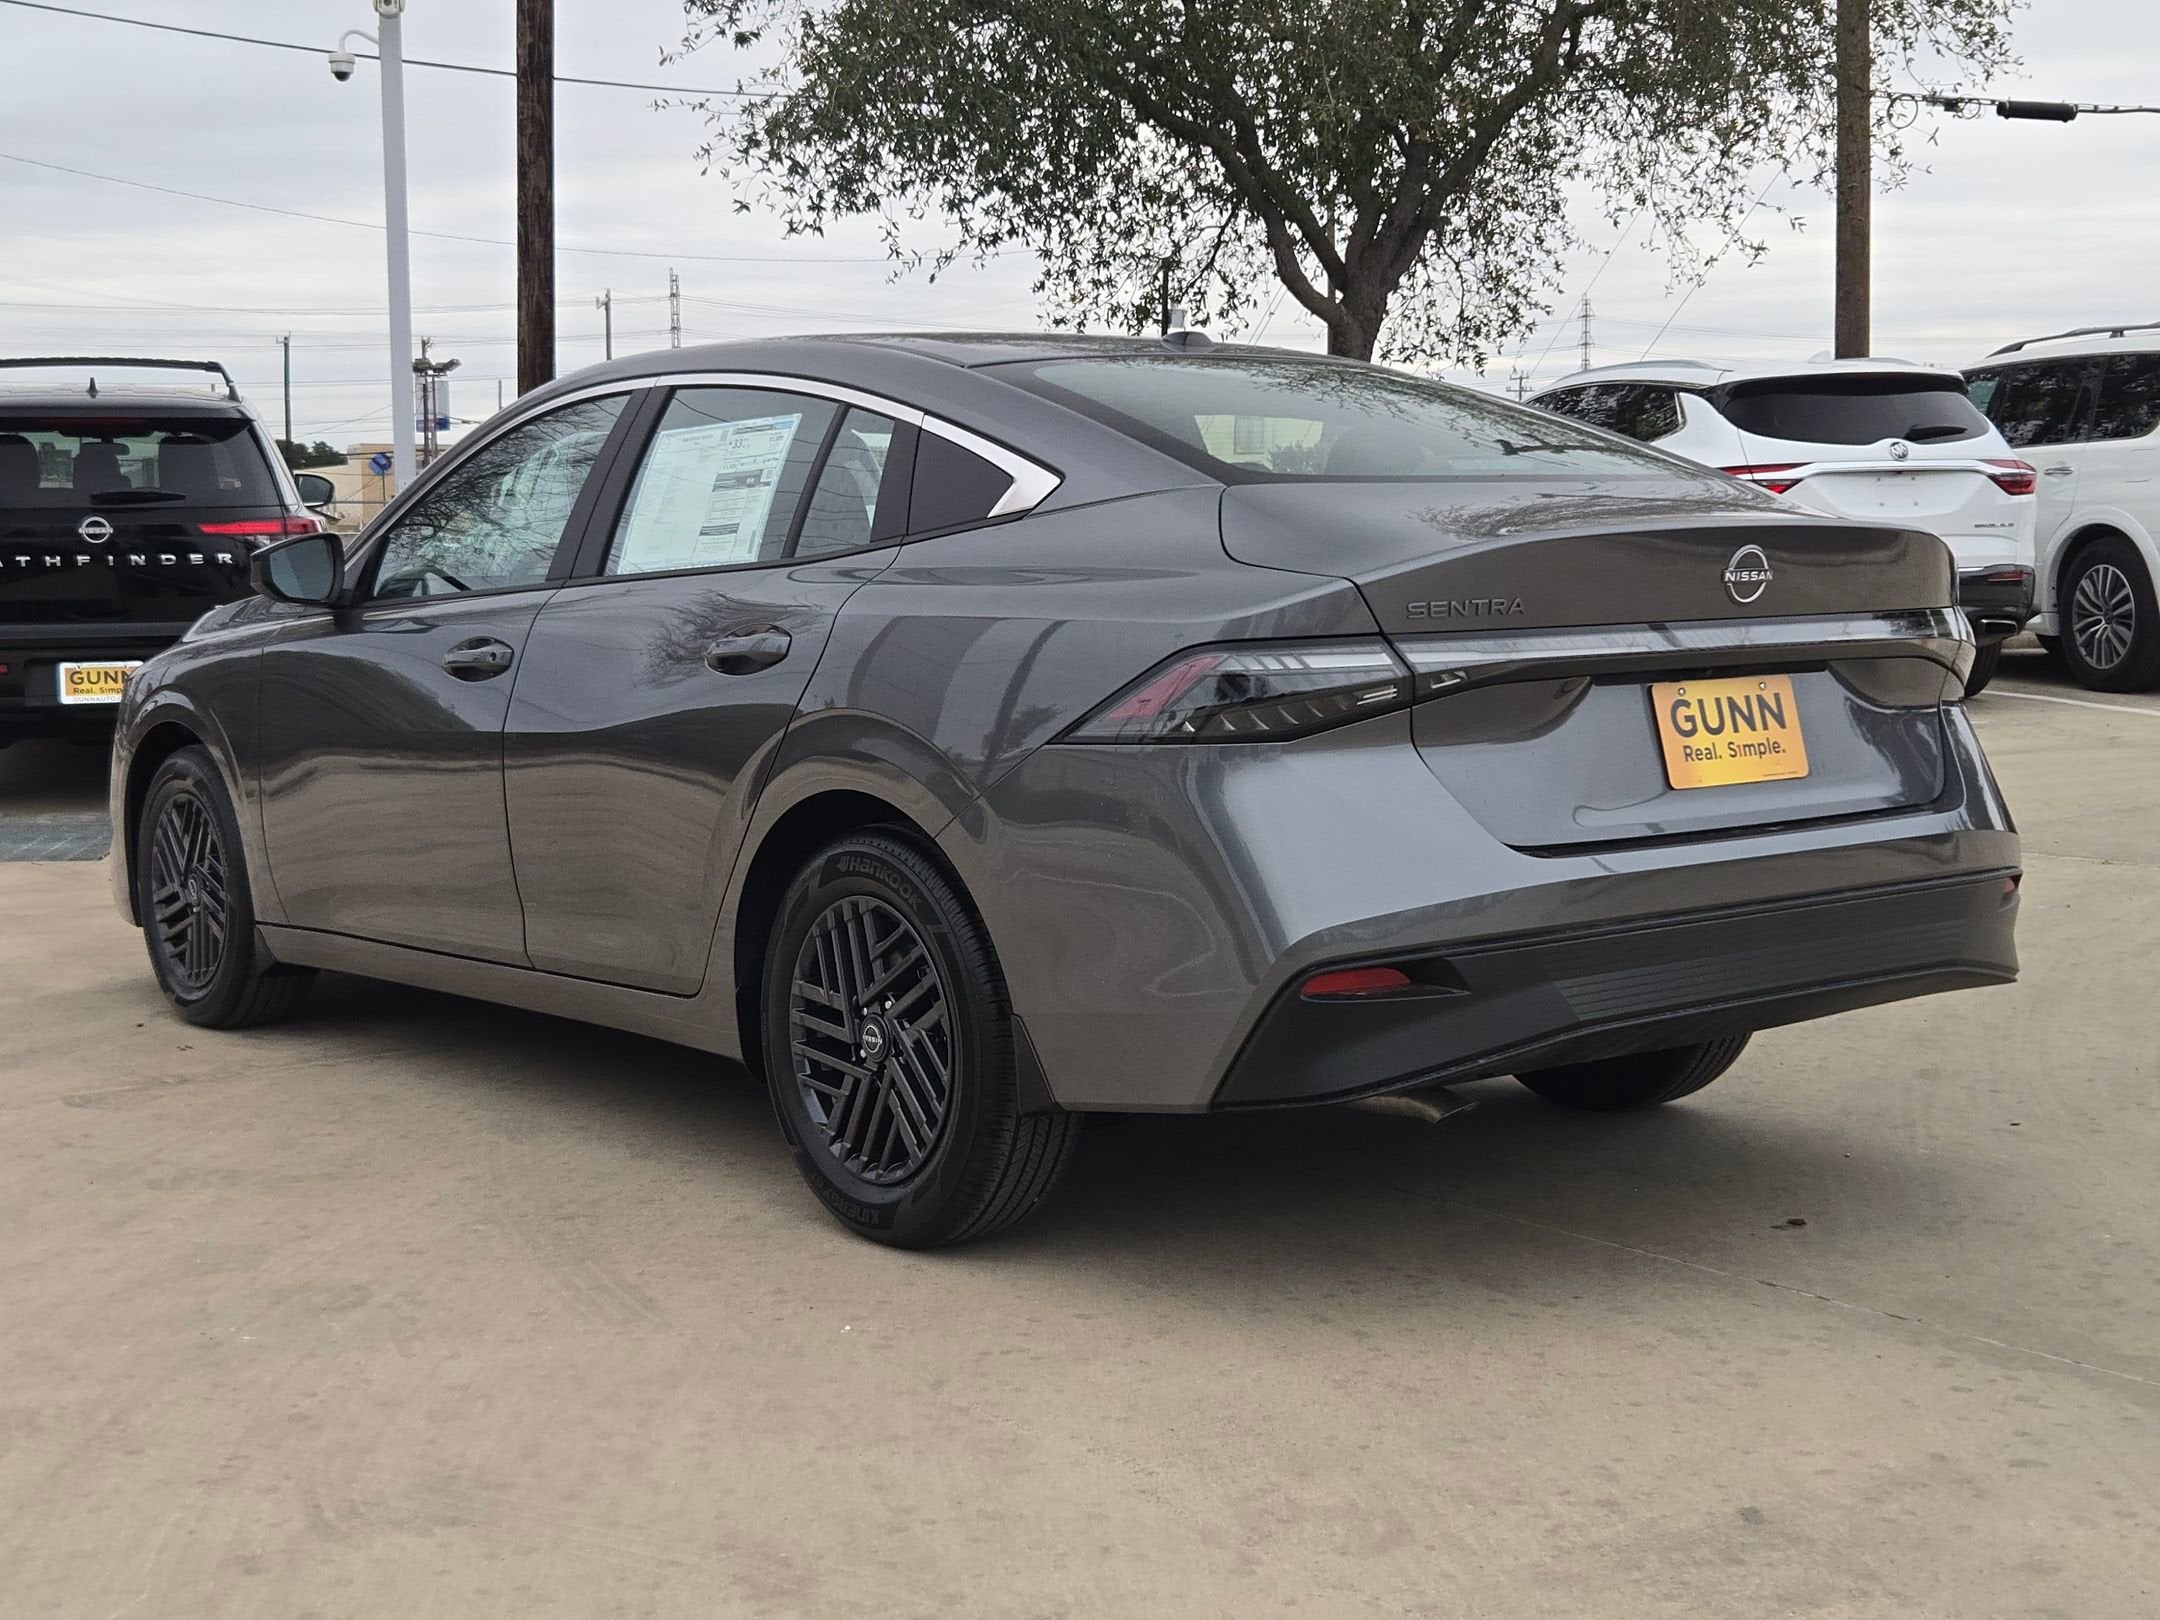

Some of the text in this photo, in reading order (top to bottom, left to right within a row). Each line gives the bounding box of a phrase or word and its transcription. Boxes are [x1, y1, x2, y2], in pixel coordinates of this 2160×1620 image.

[1724, 570, 1774, 582] NISSAN
[1406, 597, 1526, 619] SENTRA
[73, 687, 96, 695] Real.
[1670, 692, 1787, 738] GUNN
[1683, 743, 1722, 762] Real.
